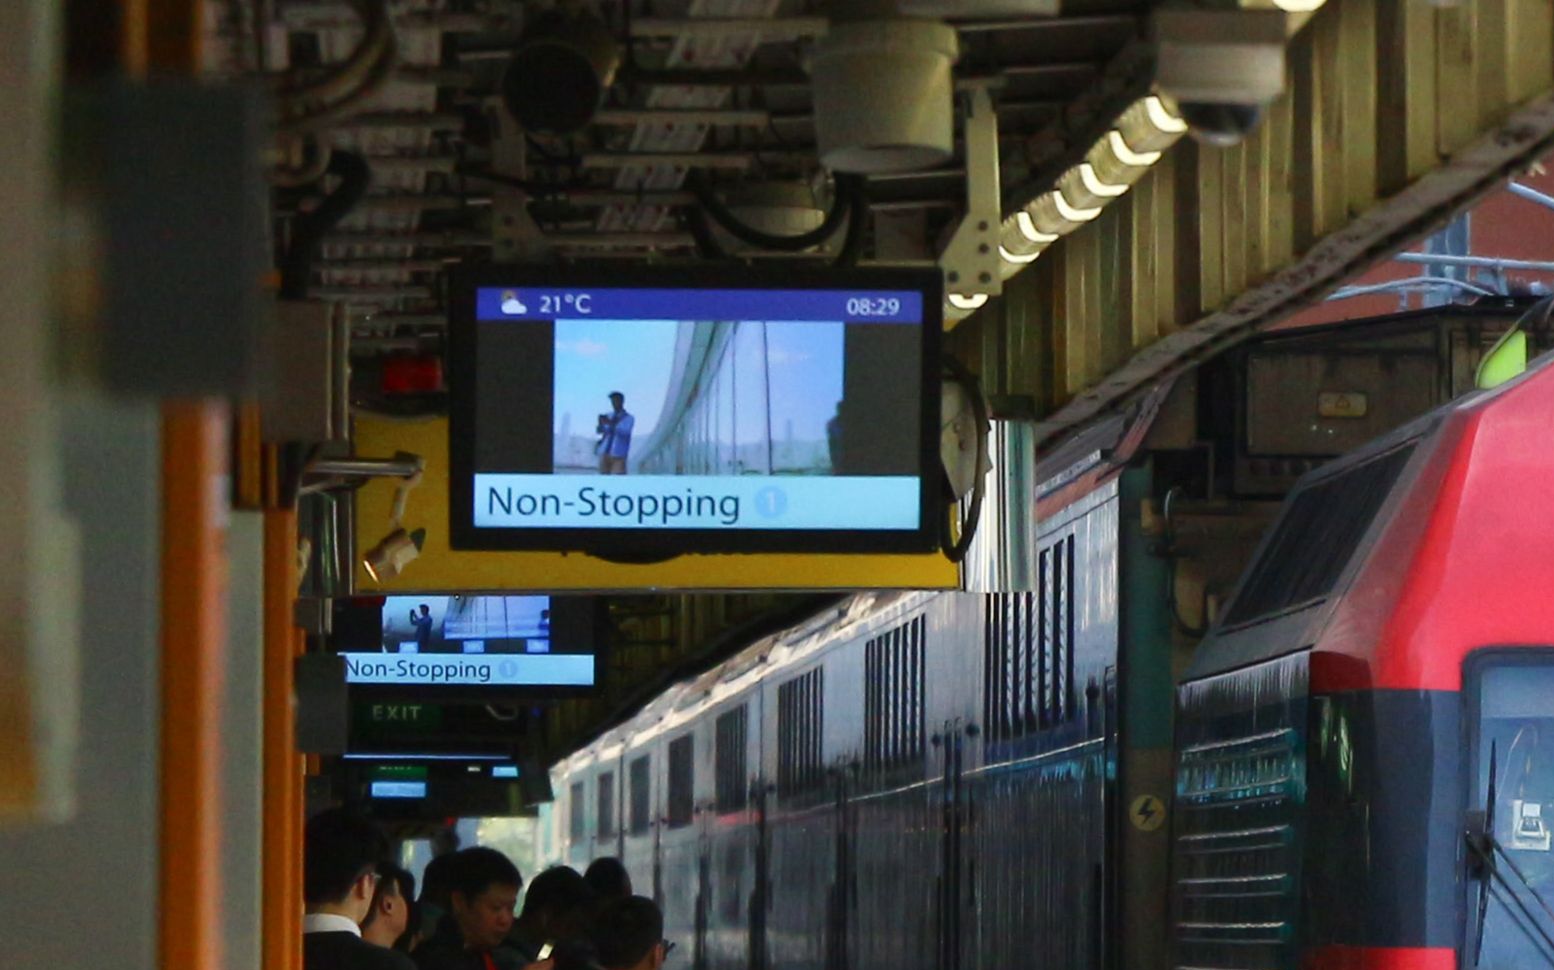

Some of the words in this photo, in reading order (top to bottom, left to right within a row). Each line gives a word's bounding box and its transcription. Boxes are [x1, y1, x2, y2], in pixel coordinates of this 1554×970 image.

[540, 293, 592, 314] 21°C
[846, 298, 900, 316] 08:29
[488, 486, 741, 526] Non-Stopping
[347, 659, 491, 682] Non-Stopping
[372, 705, 422, 720] EXIT
